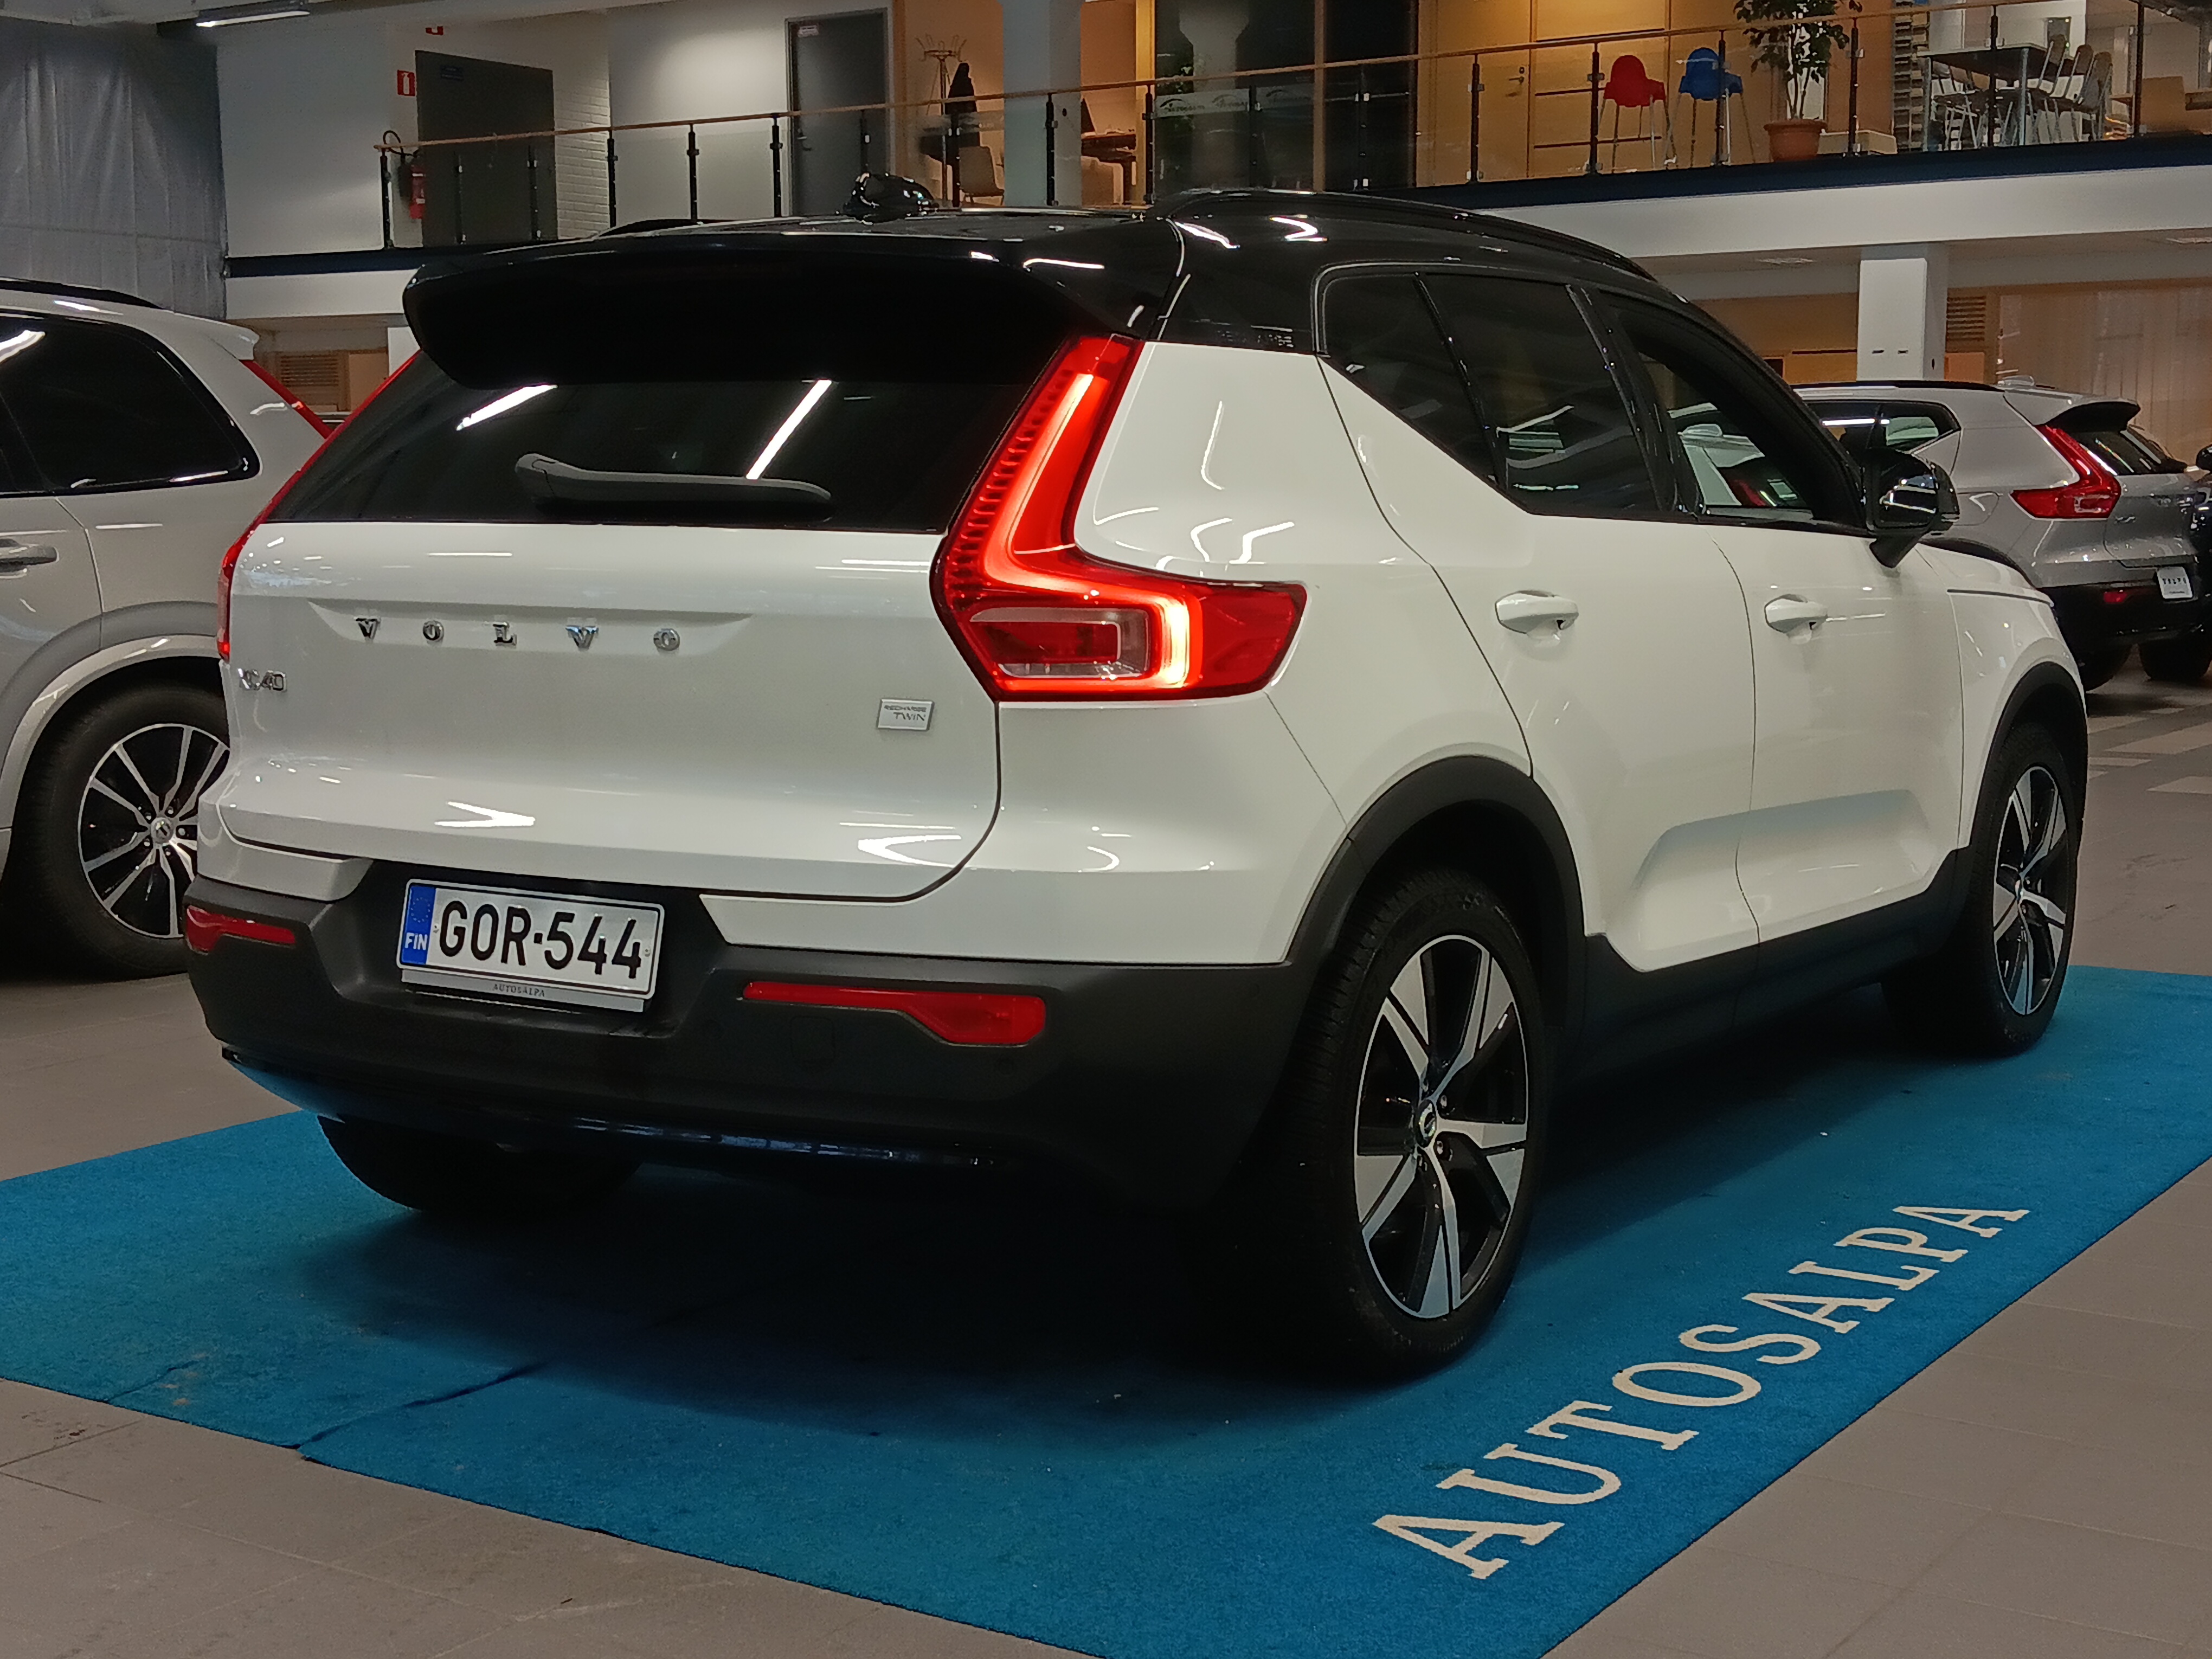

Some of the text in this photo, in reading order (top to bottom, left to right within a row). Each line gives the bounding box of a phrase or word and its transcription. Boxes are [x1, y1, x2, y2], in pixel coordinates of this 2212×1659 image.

[353, 616, 681, 652] VOLVO
[893, 711, 926, 721] TWIN
[404, 932, 428, 951] FIN
[439, 901, 642, 979] GOR-544
[492, 983, 545, 997] AUTOSALPA
[1372, 1205, 2030, 1579] AUTOSALPA
